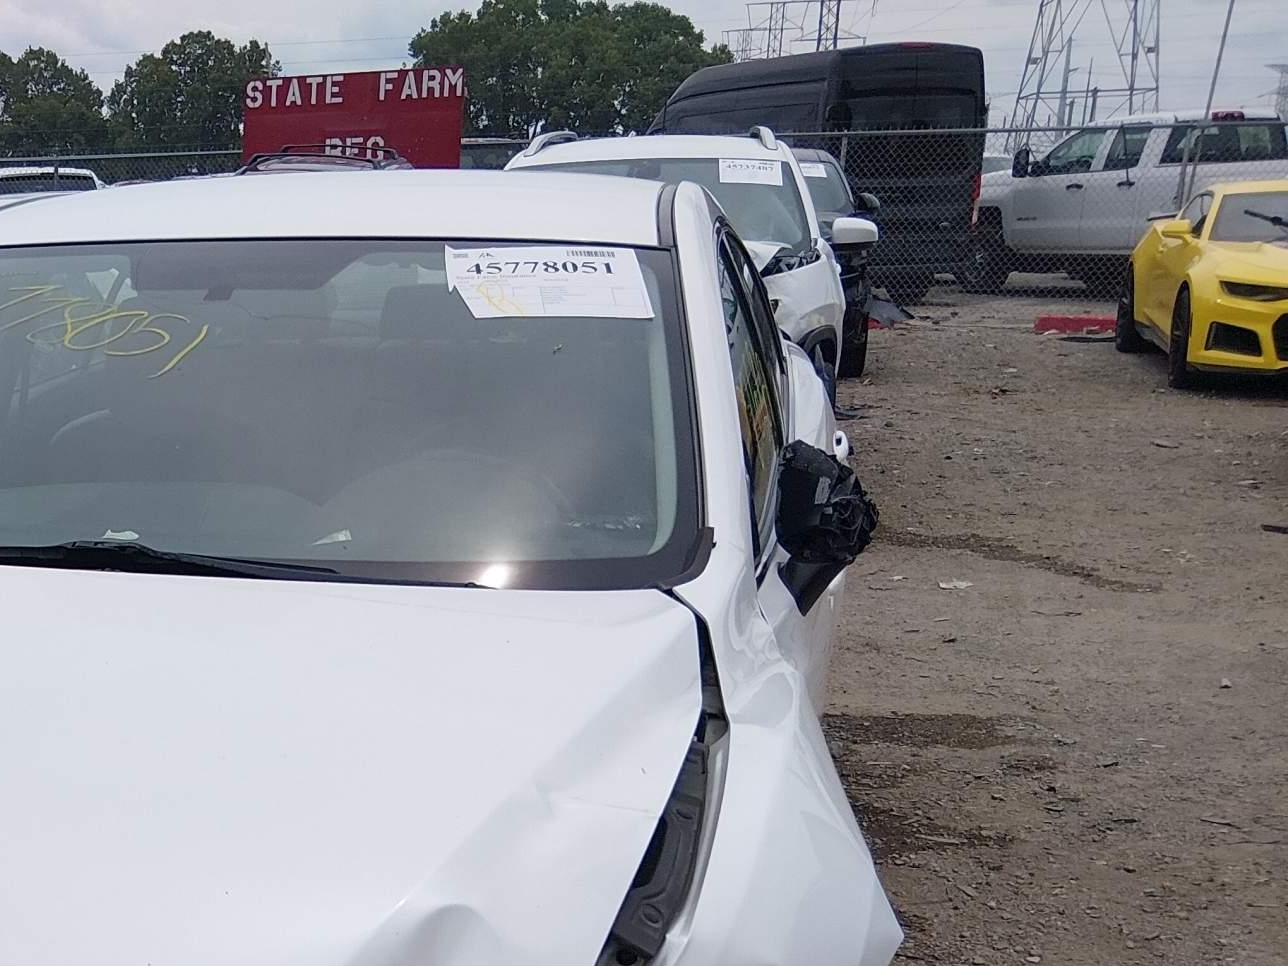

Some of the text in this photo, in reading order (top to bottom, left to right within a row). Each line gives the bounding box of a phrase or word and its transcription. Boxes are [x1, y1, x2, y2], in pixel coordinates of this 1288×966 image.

[245, 67, 464, 109] STATE FARM
[466, 260, 616, 275] 45778051
